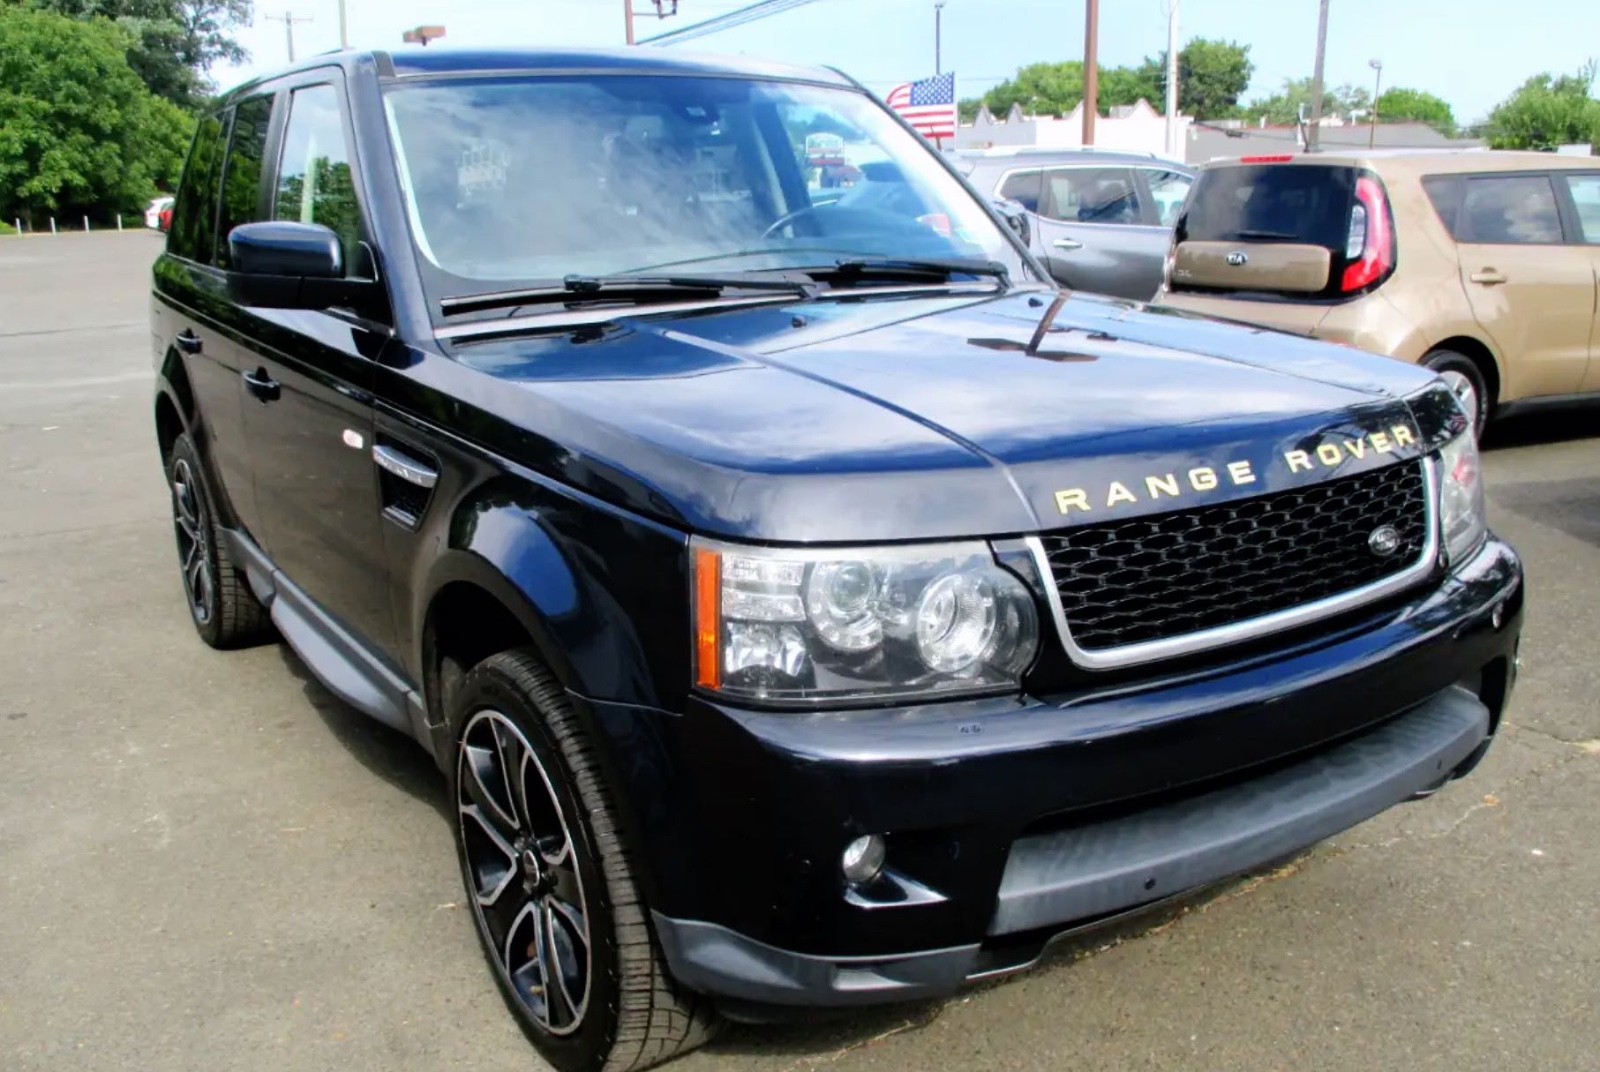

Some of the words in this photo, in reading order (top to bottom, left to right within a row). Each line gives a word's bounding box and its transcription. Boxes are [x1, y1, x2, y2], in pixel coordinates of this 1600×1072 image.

[1227, 253, 1245, 265] KIA
[1054, 460, 1256, 515] RANGE
[1284, 425, 1416, 473] ROVER
